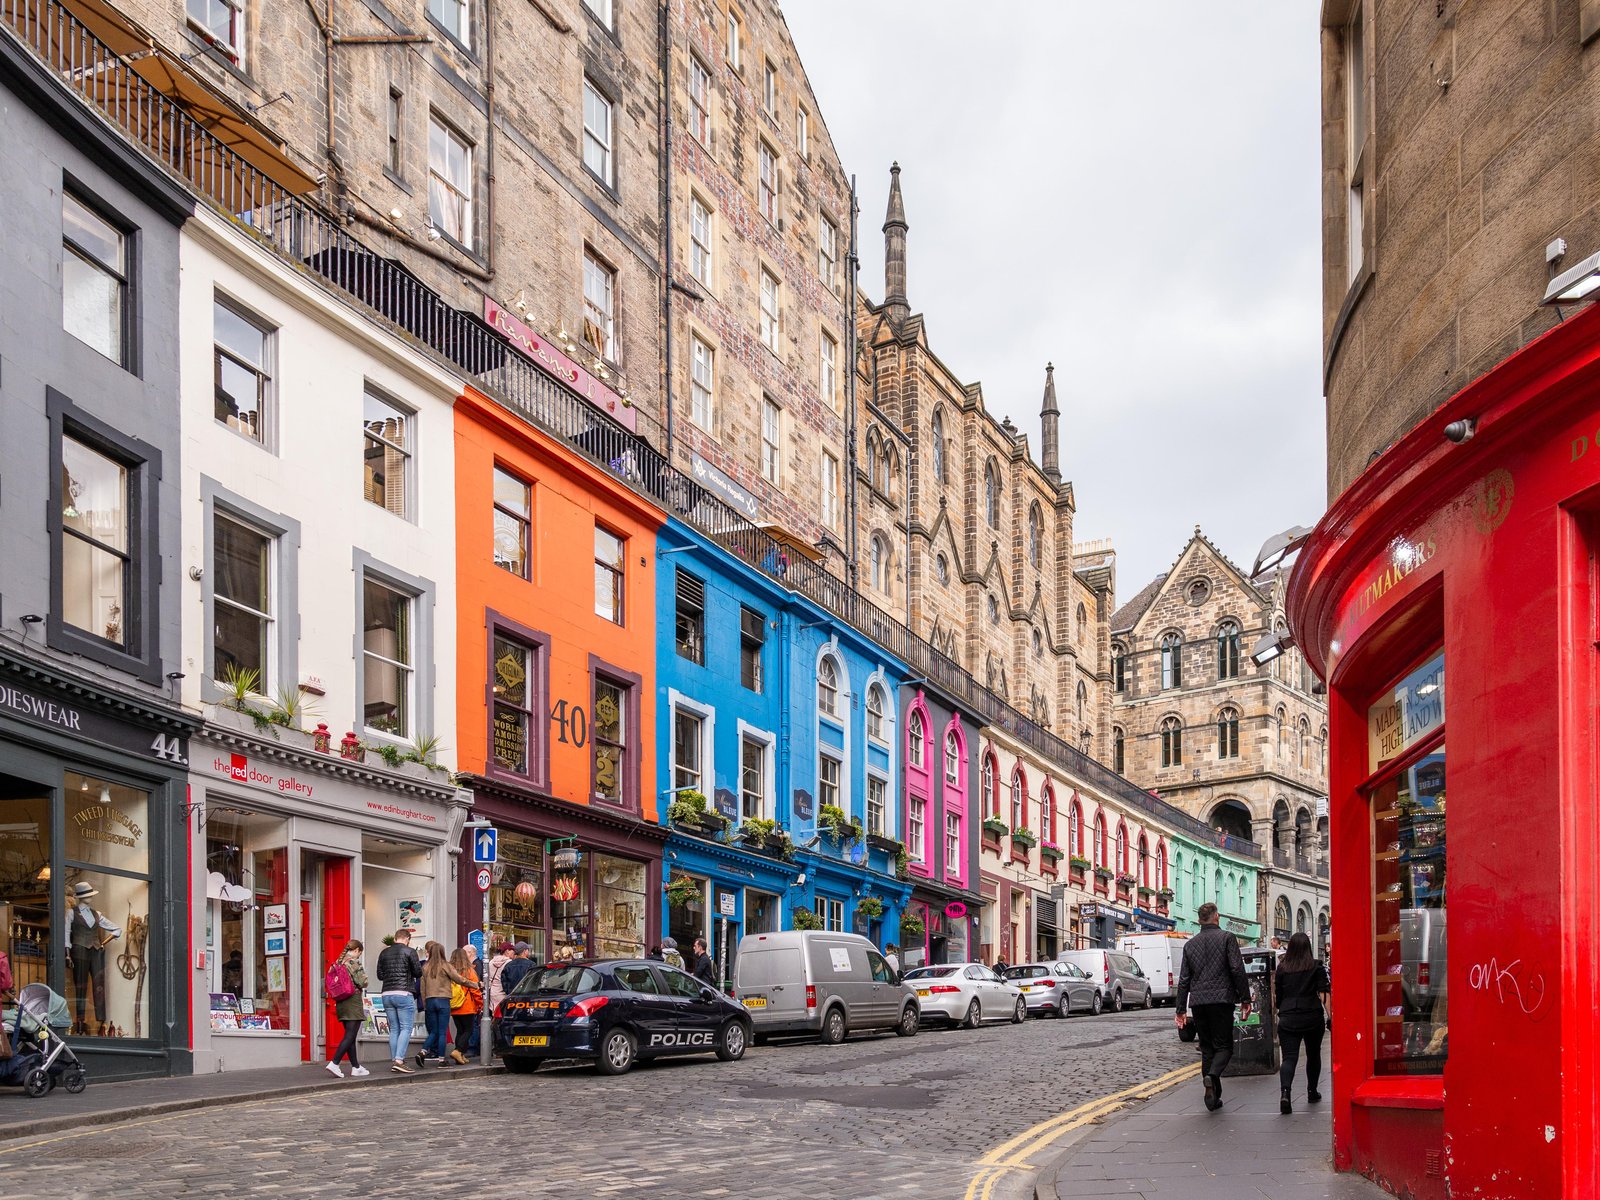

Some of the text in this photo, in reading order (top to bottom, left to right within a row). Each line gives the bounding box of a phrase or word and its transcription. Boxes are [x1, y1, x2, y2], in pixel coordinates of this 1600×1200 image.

[1570, 427, 1600, 463] D
[600, 704, 615, 718] BEST
[1375, 700, 1403, 737] MADE
[1403, 689, 1414, 714] IN
[551, 699, 586, 748] 40
[1381, 705, 1431, 758] HIGHLAND
[494, 730, 522, 743] AMOUS
[214, 757, 313, 797] the red door gallery
[73, 806, 104, 826] TWEED
[367, 801, 436, 822] www.edinburghart.com
[723, 805, 737, 816] BLEUE
[801, 806, 812, 817] BLEUE
[507, 1001, 560, 1009] POLICE
[530, 1036, 542, 1044] EYK
[650, 1032, 714, 1046] POLICE
